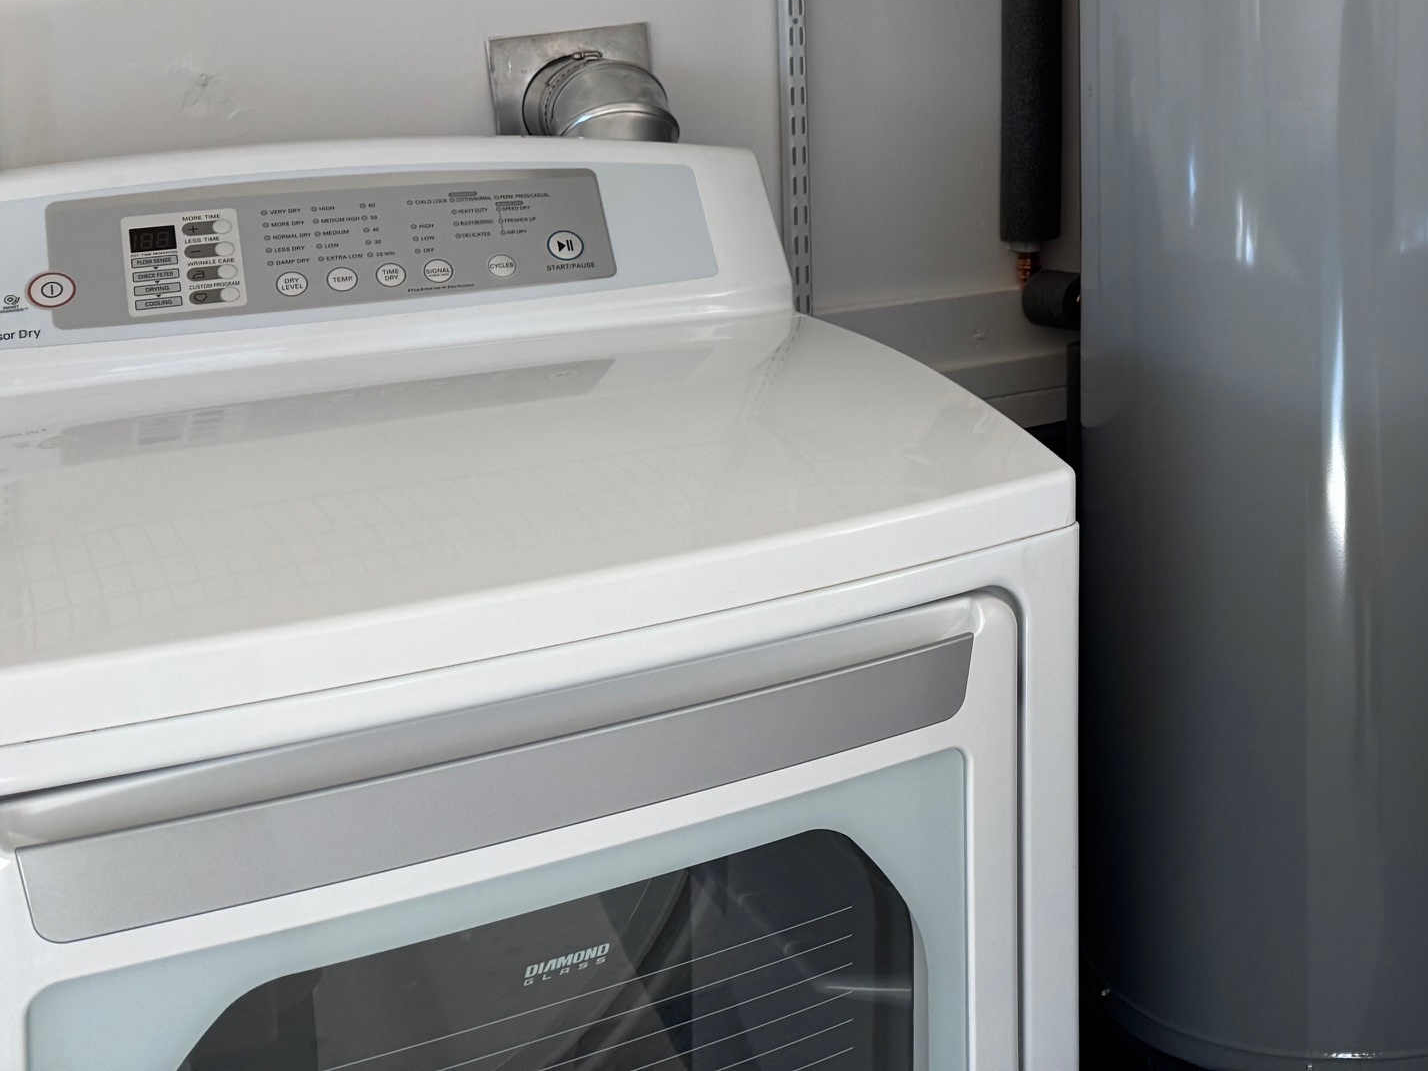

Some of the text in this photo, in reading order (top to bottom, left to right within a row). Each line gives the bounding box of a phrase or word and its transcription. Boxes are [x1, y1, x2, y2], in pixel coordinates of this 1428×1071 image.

[425, 267, 451, 275] SIGNAL
[546, 262, 596, 272] START/PAUSE
[281, 283, 304, 291] LEVEL
[145, 299, 173, 307] COOLING
[19, 329, 41, 339] Dry
[524, 942, 610, 979] DIAMOND
[523, 955, 607, 987] GLASS
